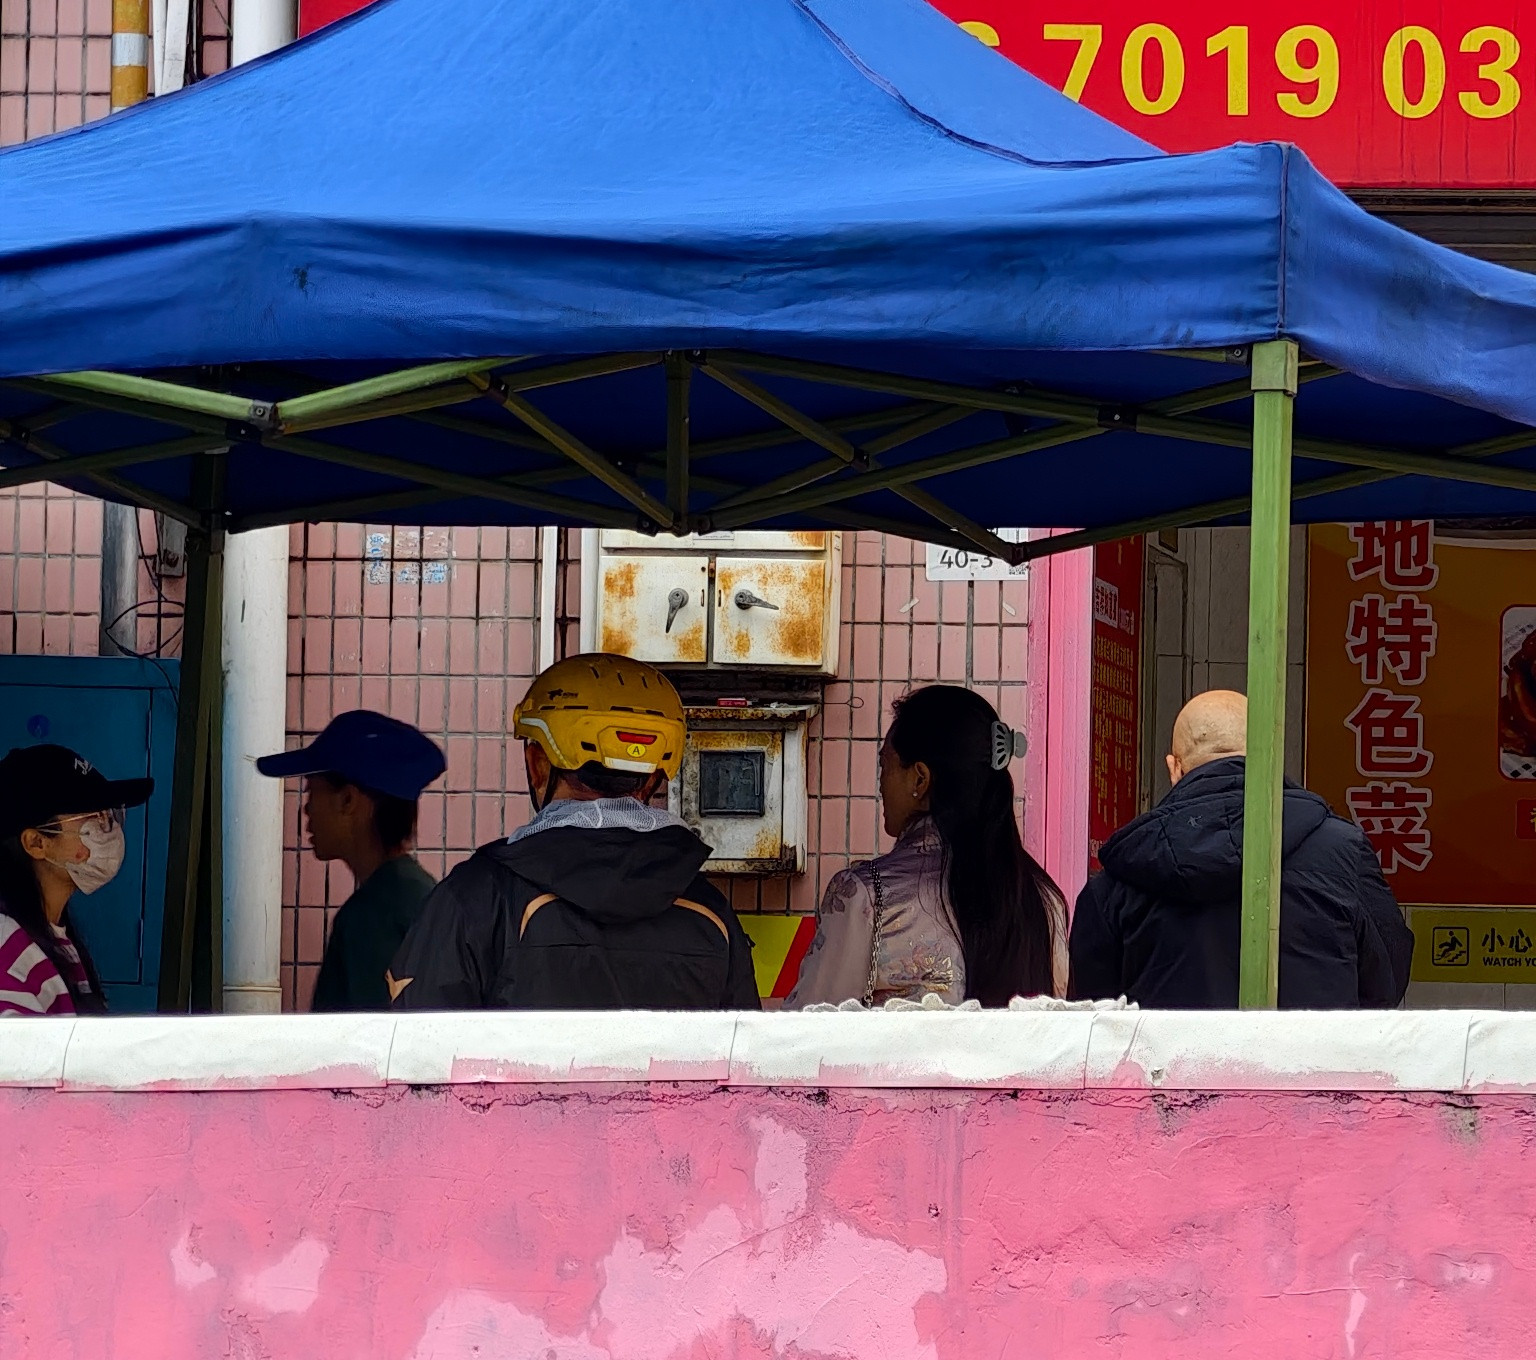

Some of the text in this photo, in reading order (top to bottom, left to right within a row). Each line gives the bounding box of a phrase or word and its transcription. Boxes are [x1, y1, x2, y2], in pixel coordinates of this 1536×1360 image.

[1043, 23, 1340, 118] 7019
[1346, 520, 1438, 872] 地特色菜
[1483, 957, 1522, 967] WATCH
